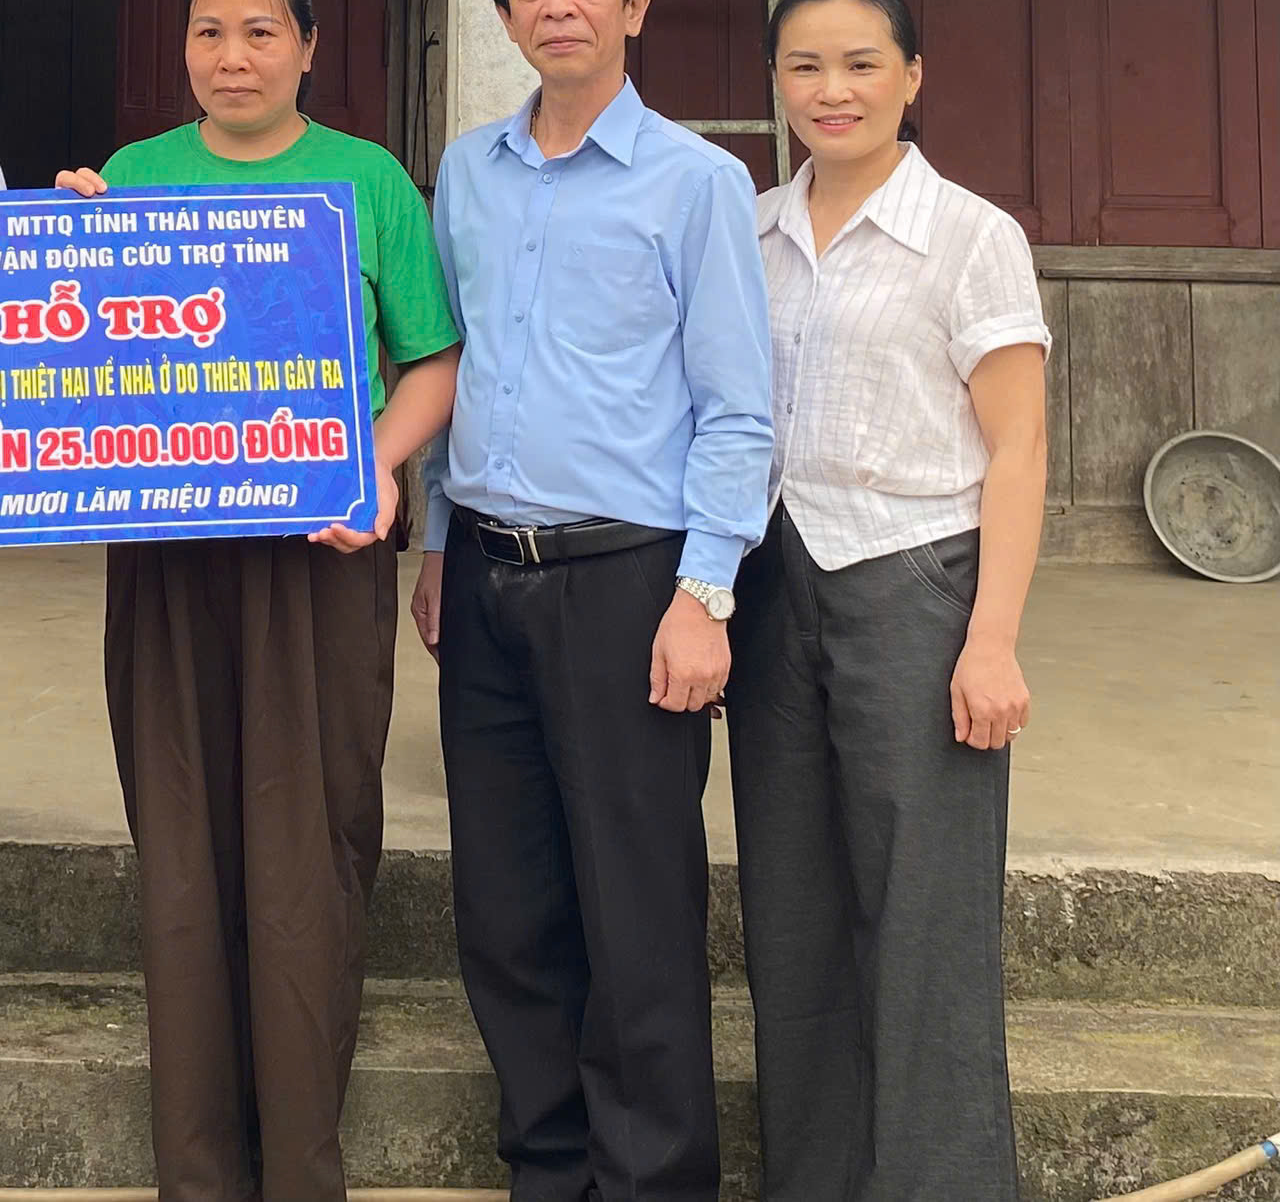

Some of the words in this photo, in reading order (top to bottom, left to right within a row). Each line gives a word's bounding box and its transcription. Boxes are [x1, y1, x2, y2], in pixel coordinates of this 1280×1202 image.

[8, 215, 73, 237] MTTQ
[81, 207, 137, 233] TỈNH
[145, 207, 199, 231] THÁI
[208, 206, 305, 230] NGUYÊN
[46, 244, 113, 272] ĐỘNG
[122, 242, 171, 266] CỨU
[179, 242, 225, 268] TRỢ
[232, 237, 289, 263] TỈNH
[0, 281, 88, 342] HỖ
[99, 288, 224, 346] TRỢ
[11, 362, 56, 406] THIỆT
[62, 367, 89, 404] HẠI
[94, 356, 115, 396] VỀ
[120, 358, 155, 395] NHÀ
[160, 353, 170, 394] Ở
[176, 363, 198, 393] DO
[202, 356, 251, 392] THIÊN
[255, 361, 279, 391] TAI
[284, 353, 315, 391] GÂY
[321, 359, 344, 389] RA
[38, 423, 237, 469] 25.000.000
[243, 408, 347, 462] ĐỒNG
[0, 491, 68, 516] MƯƠI
[76, 486, 131, 512] LĂM
[140, 483, 211, 513] TRIỆU
[219, 478, 298, 507] ĐỒNG)
